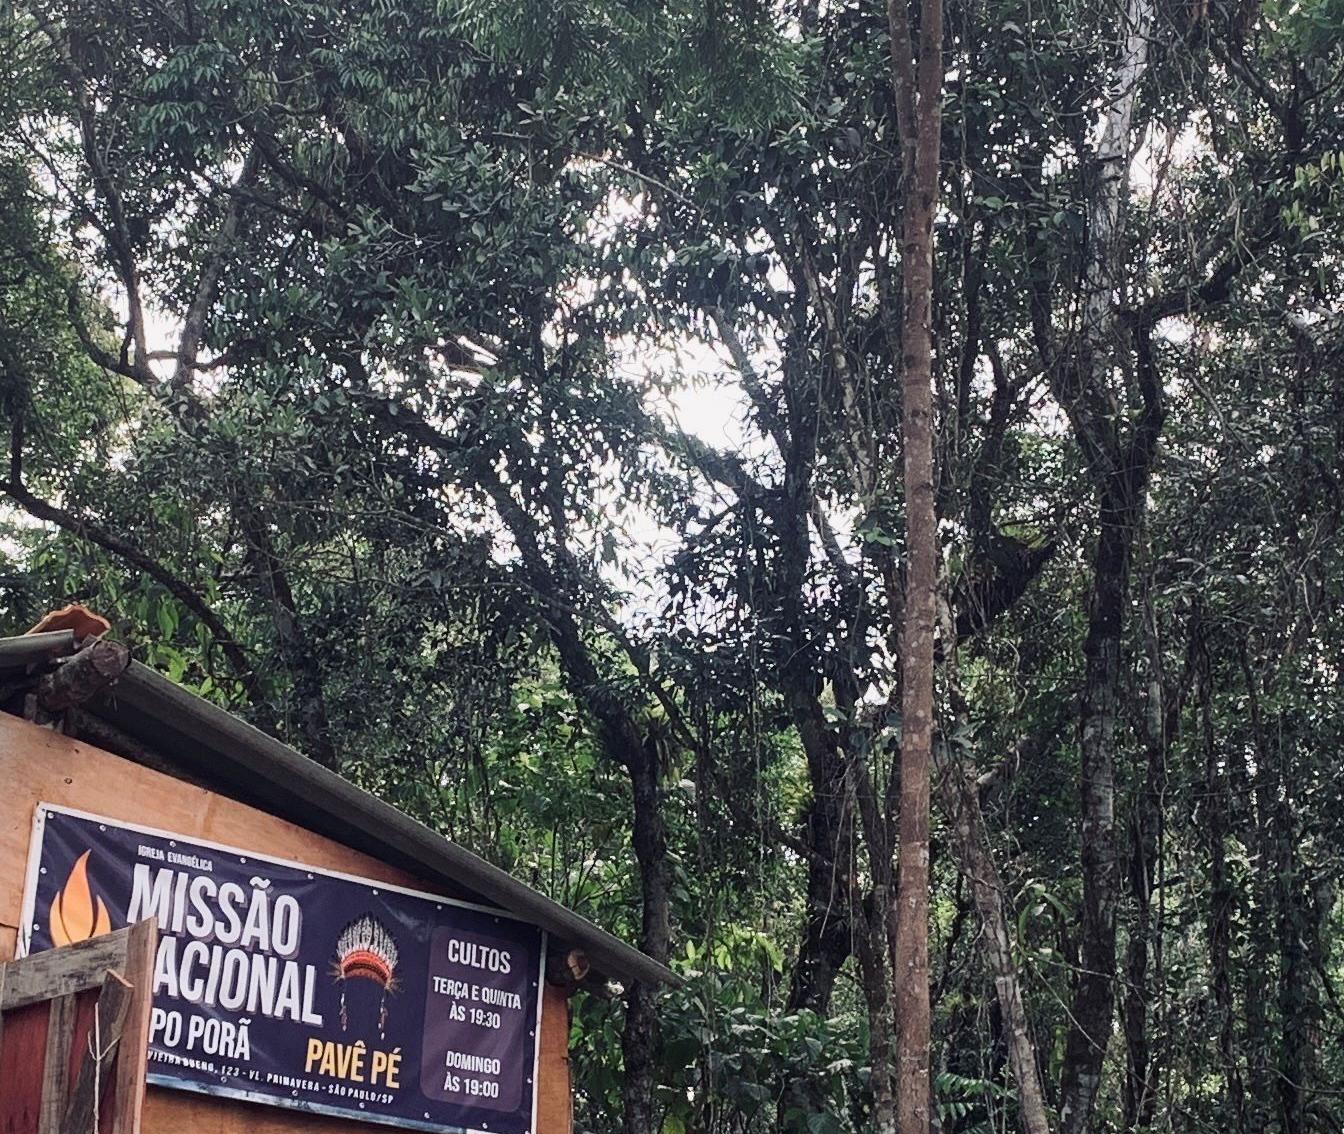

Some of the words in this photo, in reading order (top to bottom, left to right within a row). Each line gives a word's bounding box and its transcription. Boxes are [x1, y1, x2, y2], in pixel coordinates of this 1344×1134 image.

[138, 845, 165, 860] IGREJA
[126, 863, 301, 955] MISSÃO
[448, 939, 511, 974] CULTOS
[153, 935, 323, 1025] ACIONAL
[433, 976, 469, 1000] TERÇA
[471, 985, 480, 1001] E
[481, 987, 521, 1010] QUINTA
[449, 1001, 466, 1021] ÀS
[469, 1008, 501, 1029] 19:30
[148, 1007, 183, 1047] PO
[186, 1015, 251, 1060] PORÃ
[305, 1038, 367, 1082] PAVÊ
[370, 1047, 402, 1089] PÉ
[446, 1051, 501, 1075] DOMINGO
[221, 1066, 240, 1077] 123
[266, 1073, 320, 1092] PRIMAVERA
[328, 1083, 346, 1097] SÃO
[347, 1087, 394, 1104] PAULO/SP
[444, 1071, 460, 1092] ÀS
[464, 1078, 499, 1098] 19:00
